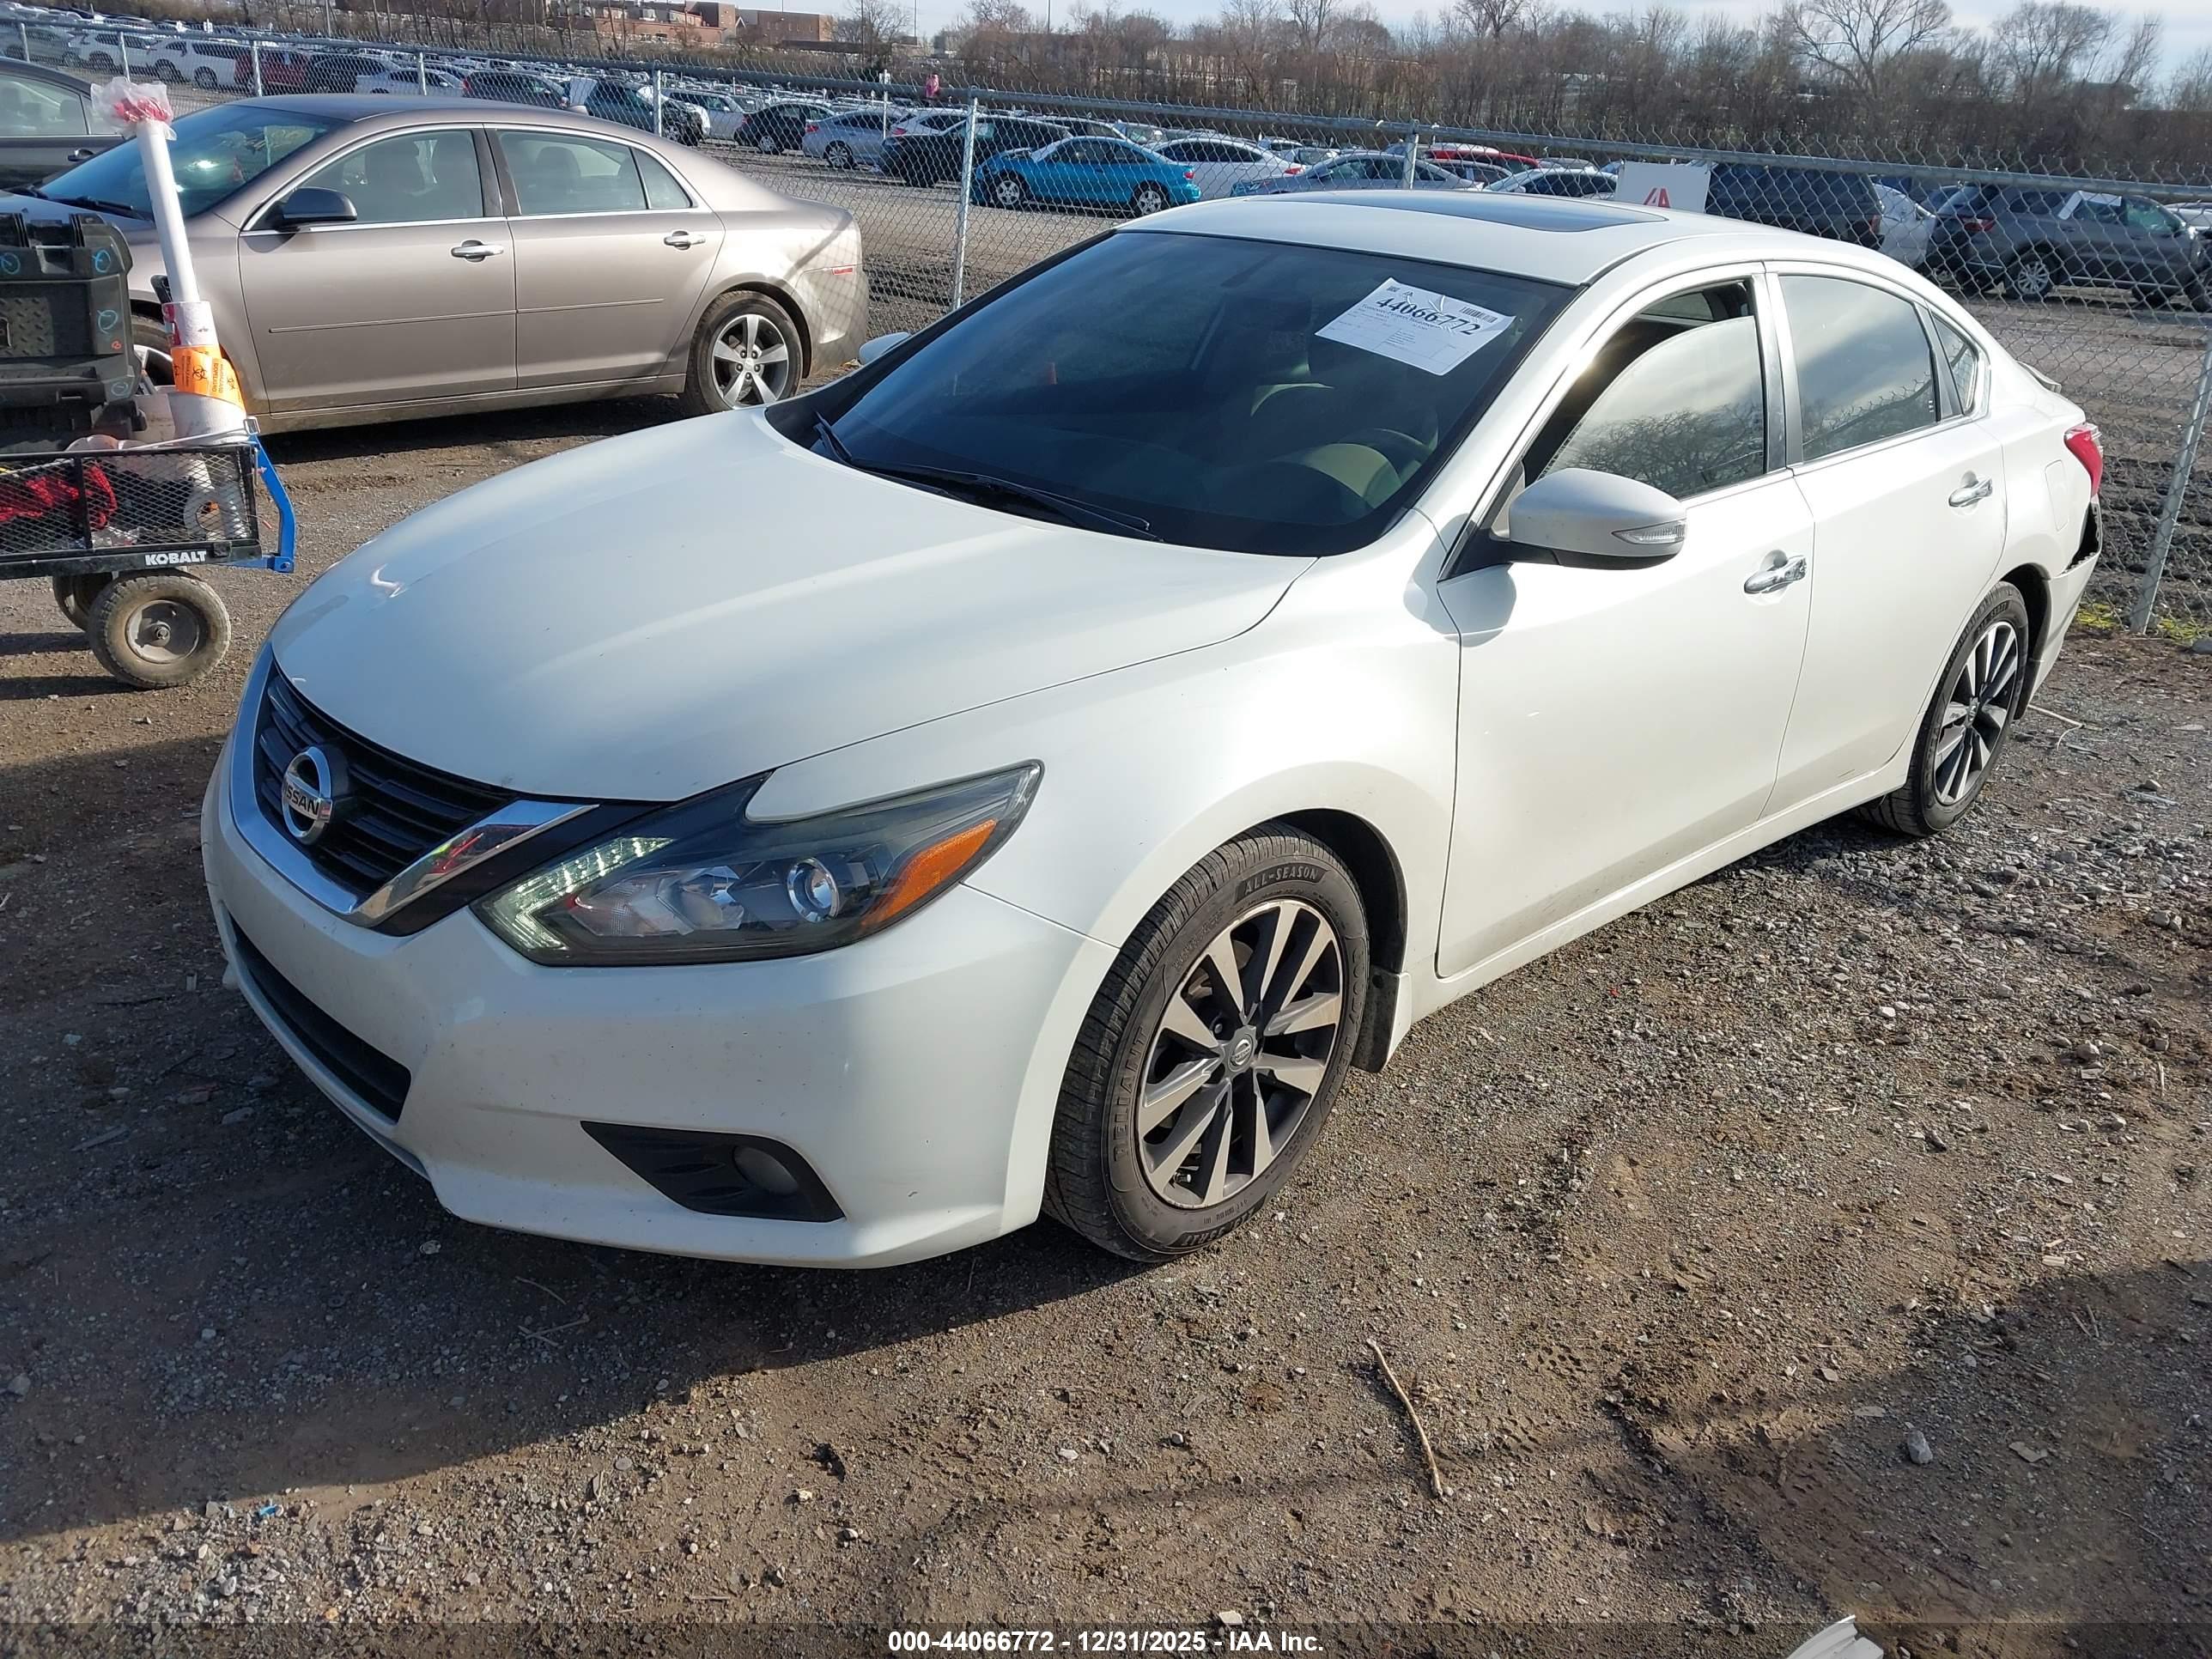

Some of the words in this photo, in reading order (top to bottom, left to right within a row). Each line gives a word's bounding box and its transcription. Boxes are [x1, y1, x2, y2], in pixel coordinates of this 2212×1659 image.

[1376, 297, 1481, 336] 44066772
[144, 550, 207, 566] KOBALT
[283, 780, 320, 816] ISSAN
[1244, 865, 1320, 896] ALL-SEASON
[1112, 1024, 1148, 1162] RELIANT
